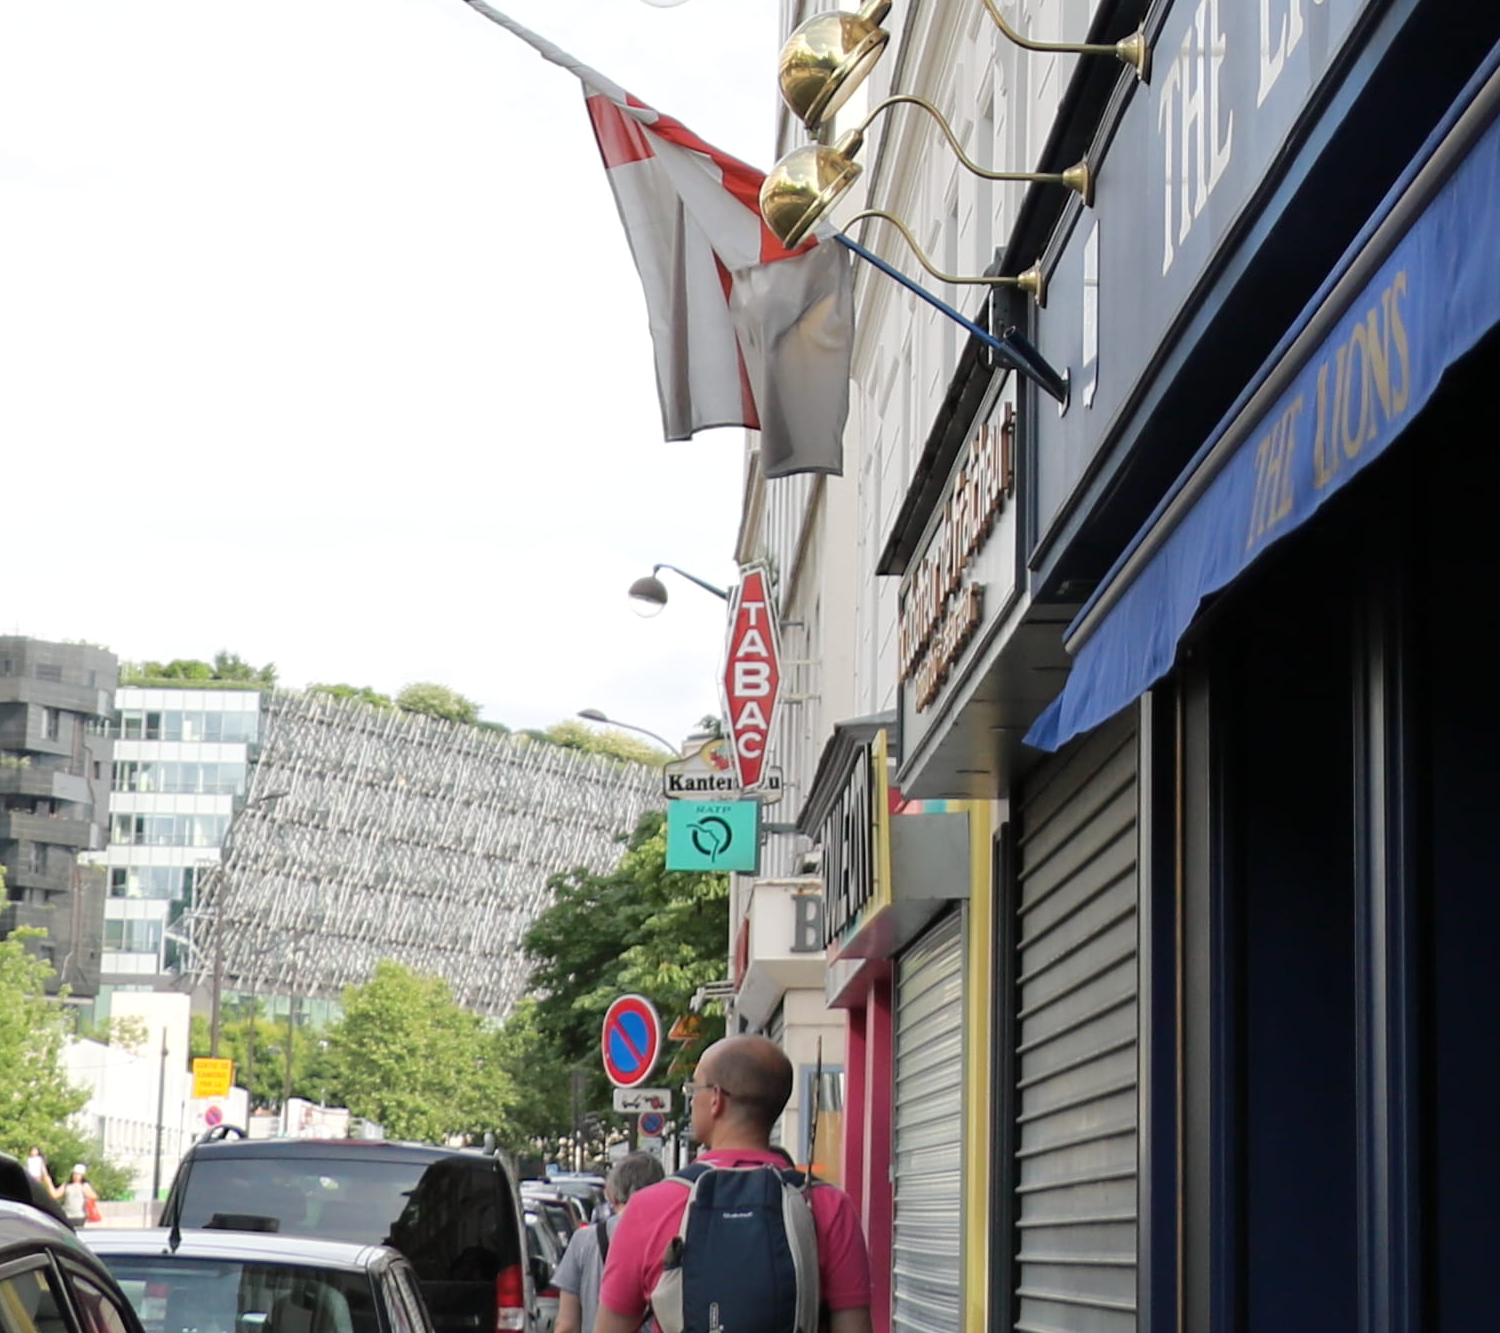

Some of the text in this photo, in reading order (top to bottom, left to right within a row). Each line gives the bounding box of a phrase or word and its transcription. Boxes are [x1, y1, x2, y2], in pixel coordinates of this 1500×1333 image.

[1247, 269, 1409, 550] THE LIONS
[732, 601, 771, 759] TABAC
[695, 805, 732, 814] RATP
